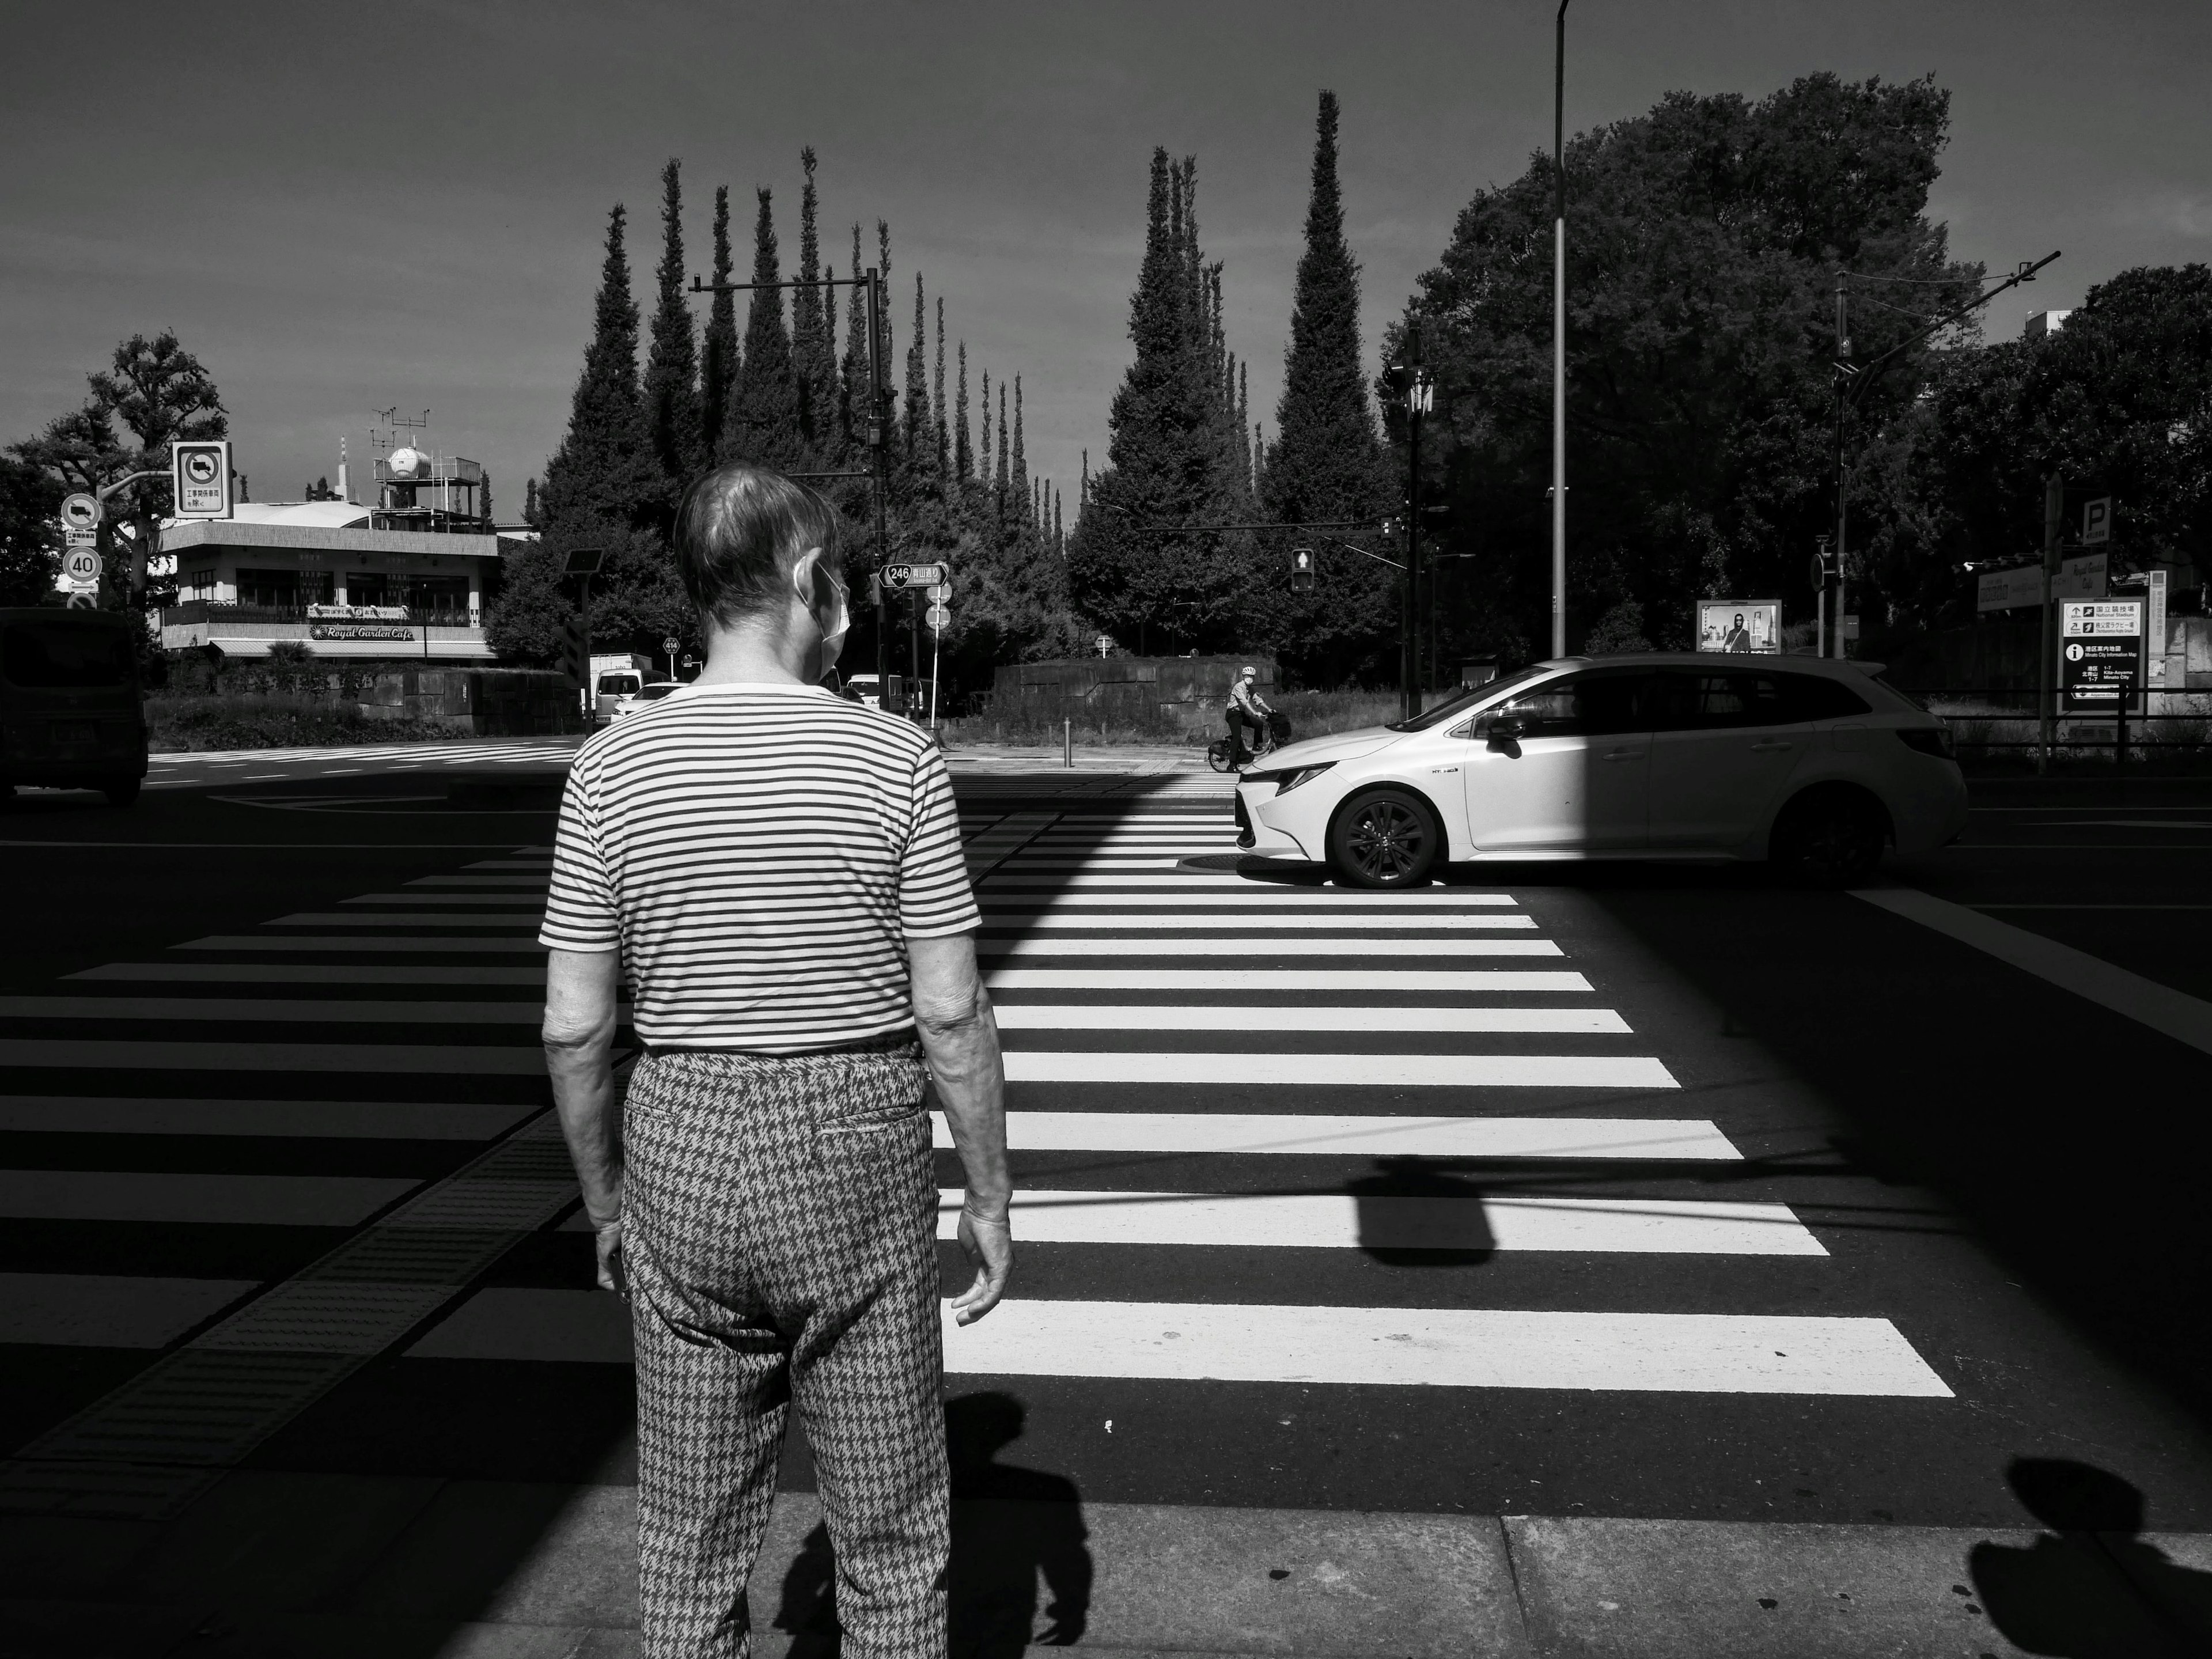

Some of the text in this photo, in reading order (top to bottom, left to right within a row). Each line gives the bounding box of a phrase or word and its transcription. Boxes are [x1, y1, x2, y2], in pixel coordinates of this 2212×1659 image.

[187, 499, 204, 507] を除く
[2088, 503, 2105, 531] P
[73, 557, 93, 572] 40
[891, 568, 909, 579] 246
[913, 568, 938, 578] 青山通り
[327, 627, 412, 641] Royal Garden Cafe
